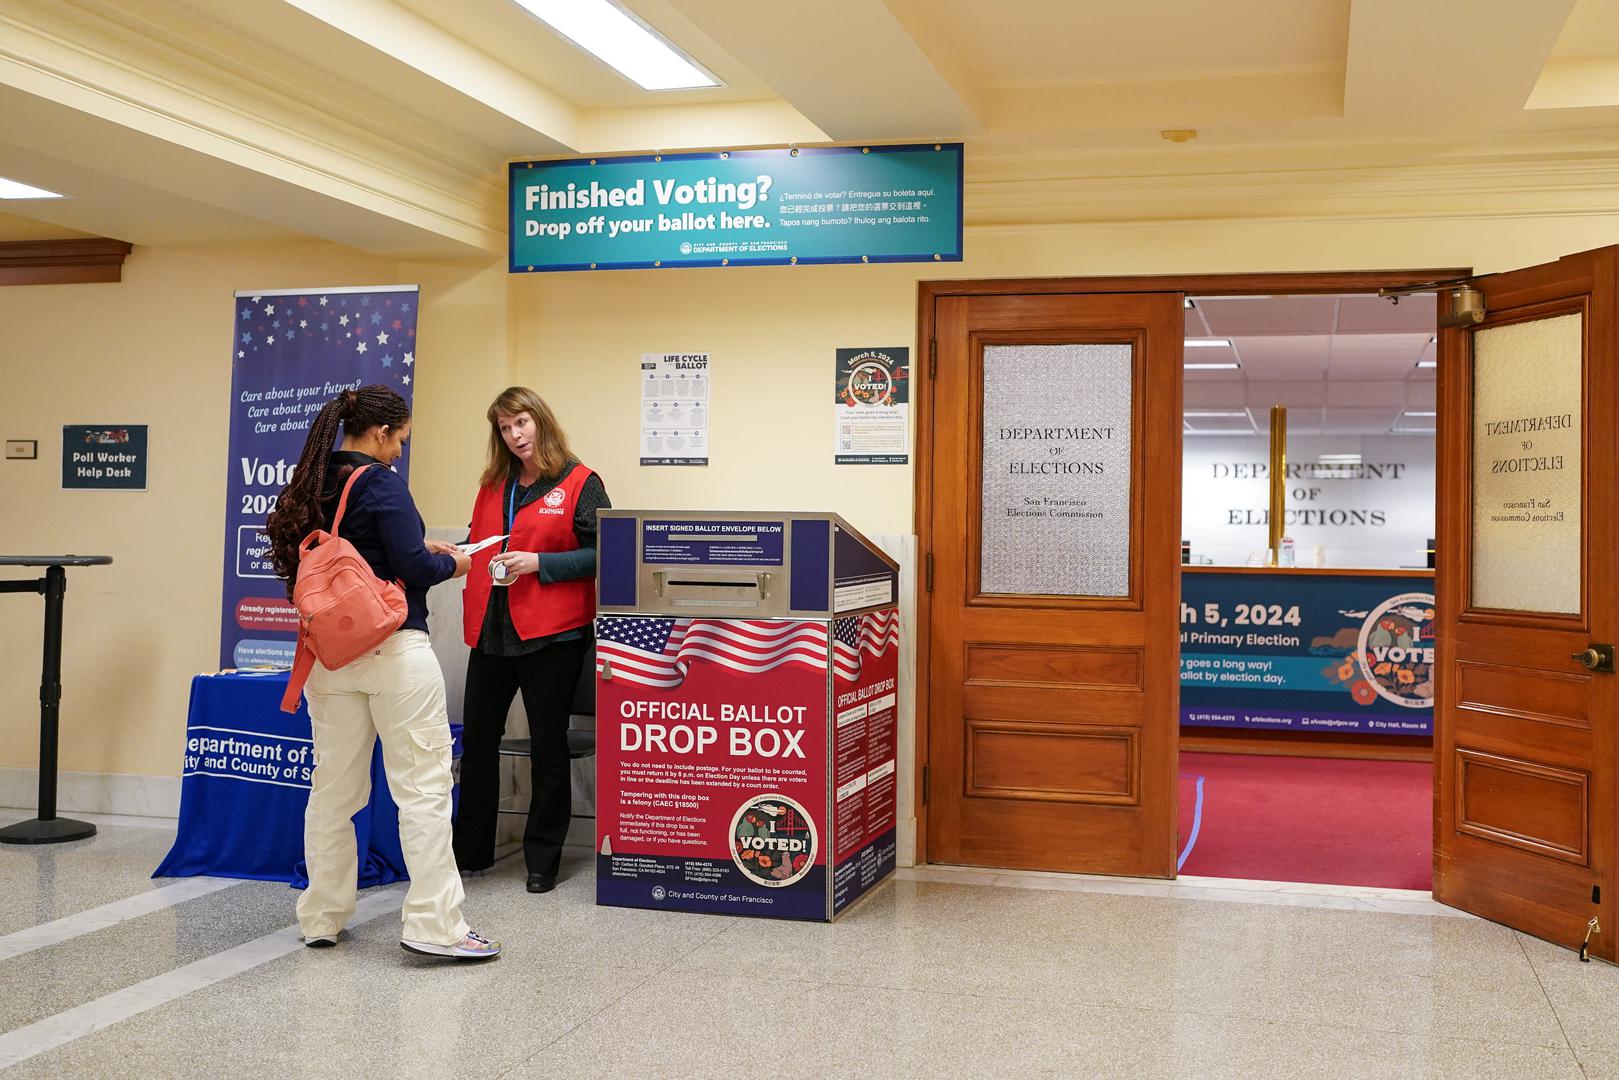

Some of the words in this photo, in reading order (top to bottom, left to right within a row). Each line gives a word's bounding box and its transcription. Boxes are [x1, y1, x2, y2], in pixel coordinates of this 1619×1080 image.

[526, 180, 645, 211] Finished
[653, 175, 773, 210] Voting?
[780, 192, 813, 202] ¿Terminó
[825, 191, 847, 199] votar?
[849, 190, 881, 199] Entregue
[526, 220, 571, 240] Drop
[576, 216, 604, 234] off
[609, 218, 653, 238] your
[658, 212, 716, 232] ballot
[720, 212, 771, 229] here.
[780, 219, 800, 227] Tapos
[822, 217, 852, 225] bumoto?
[854, 217, 876, 225] Ihulog
[848, 352, 870, 366] March
[879, 352, 894, 365] 2024
[241, 391, 263, 403] Care
[265, 388, 294, 400] about
[297, 386, 321, 397] your
[323, 379, 362, 397] future?
[248, 406, 269, 418] Care
[272, 403, 302, 415] about
[255, 422, 277, 434] Care
[280, 418, 309, 430] about
[1000, 428, 1114, 440] DEPARTMENT
[73, 452, 94, 463] Poll
[98, 453, 136, 463] Worker
[78, 467, 103, 479] Help
[106, 468, 131, 477] Desk
[1009, 462, 1104, 475] ELECTIONS
[1212, 463, 1405, 480] DEPRTMENT
[1293, 488, 1322, 500] OF
[241, 495, 278, 514] 202
[1024, 497, 1040, 506] San
[1044, 498, 1087, 506] Francisco
[1007, 509, 1046, 518] Elections
[1050, 510, 1104, 519] Commission
[240, 605, 264, 614] Already
[1205, 604, 1228, 628] 5,
[1235, 604, 1301, 626] 2024
[1191, 632, 1243, 648] Primary
[1247, 634, 1300, 646] Election
[1413, 627, 1420, 641] I
[255, 648, 283, 656] elections
[1373, 647, 1434, 663] VOTE
[1186, 661, 1211, 670] goes
[1223, 660, 1245, 671] long
[1248, 661, 1272, 672] way!
[1181, 671, 1203, 680] allot
[1206, 672, 1218, 683] by
[1220, 673, 1261, 682] election
[1263, 674, 1286, 685] day.
[838, 692, 858, 708] OFFICIAL
[858, 685, 874, 700] BALLOT
[875, 680, 886, 695] DROP
[886, 678, 895, 691] BOX
[620, 700, 714, 721] OFFICIAL
[721, 704, 807, 724] BALLOT
[620, 723, 718, 755] DROP
[730, 727, 806, 759] BOX
[188, 738, 282, 761] epartment
[288, 746, 308, 764] of
[184, 756, 200, 770] ity
[204, 757, 227, 769] and
[232, 758, 279, 779] County
[284, 766, 298, 779] of
[620, 791, 653, 799] Tampering
[633, 799, 651, 807] felony
[770, 821, 776, 832] I
[740, 837, 806, 853] VOTED!
[668, 891, 681, 899] City
[696, 892, 719, 901] County
[728, 894, 741, 902] San
[742, 896, 773, 904] Francisco
